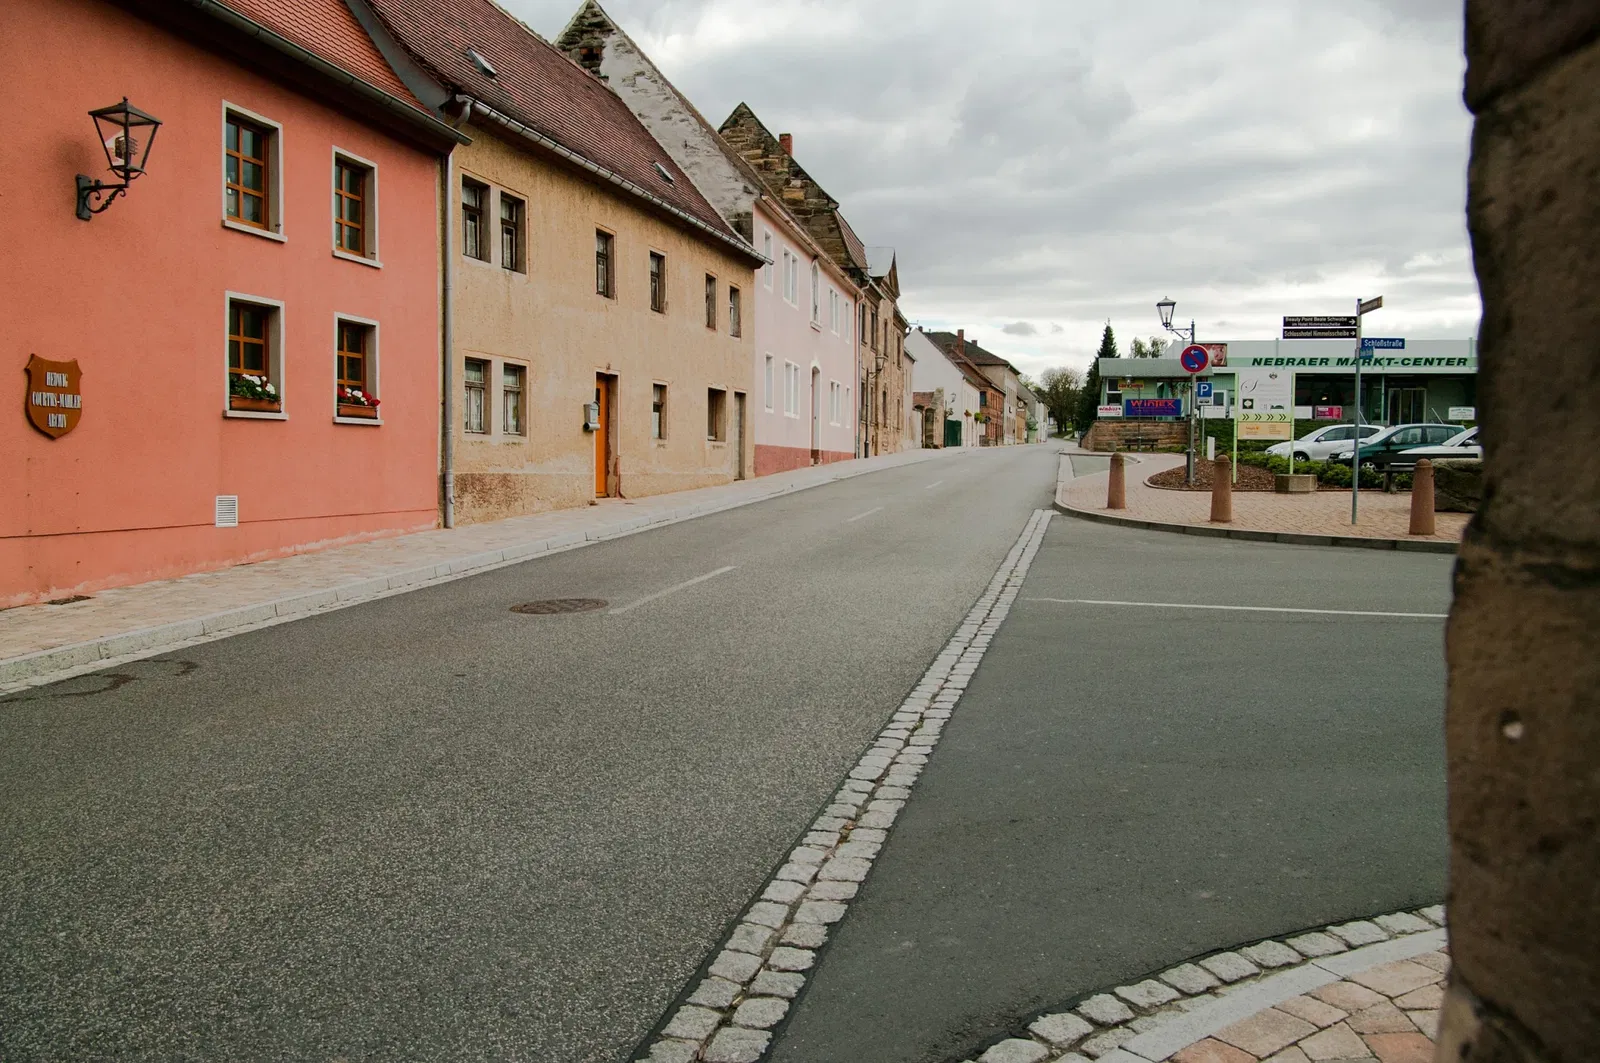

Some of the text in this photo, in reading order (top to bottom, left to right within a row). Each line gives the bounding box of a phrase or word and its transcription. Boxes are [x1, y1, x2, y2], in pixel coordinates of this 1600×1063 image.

[1364, 339, 1403, 347] Schloßstraße
[1251, 357, 1468, 366] NEBRAER MARKT-CENTER
[46, 372, 68, 387] HEDWIG
[1200, 384, 1209, 396] P
